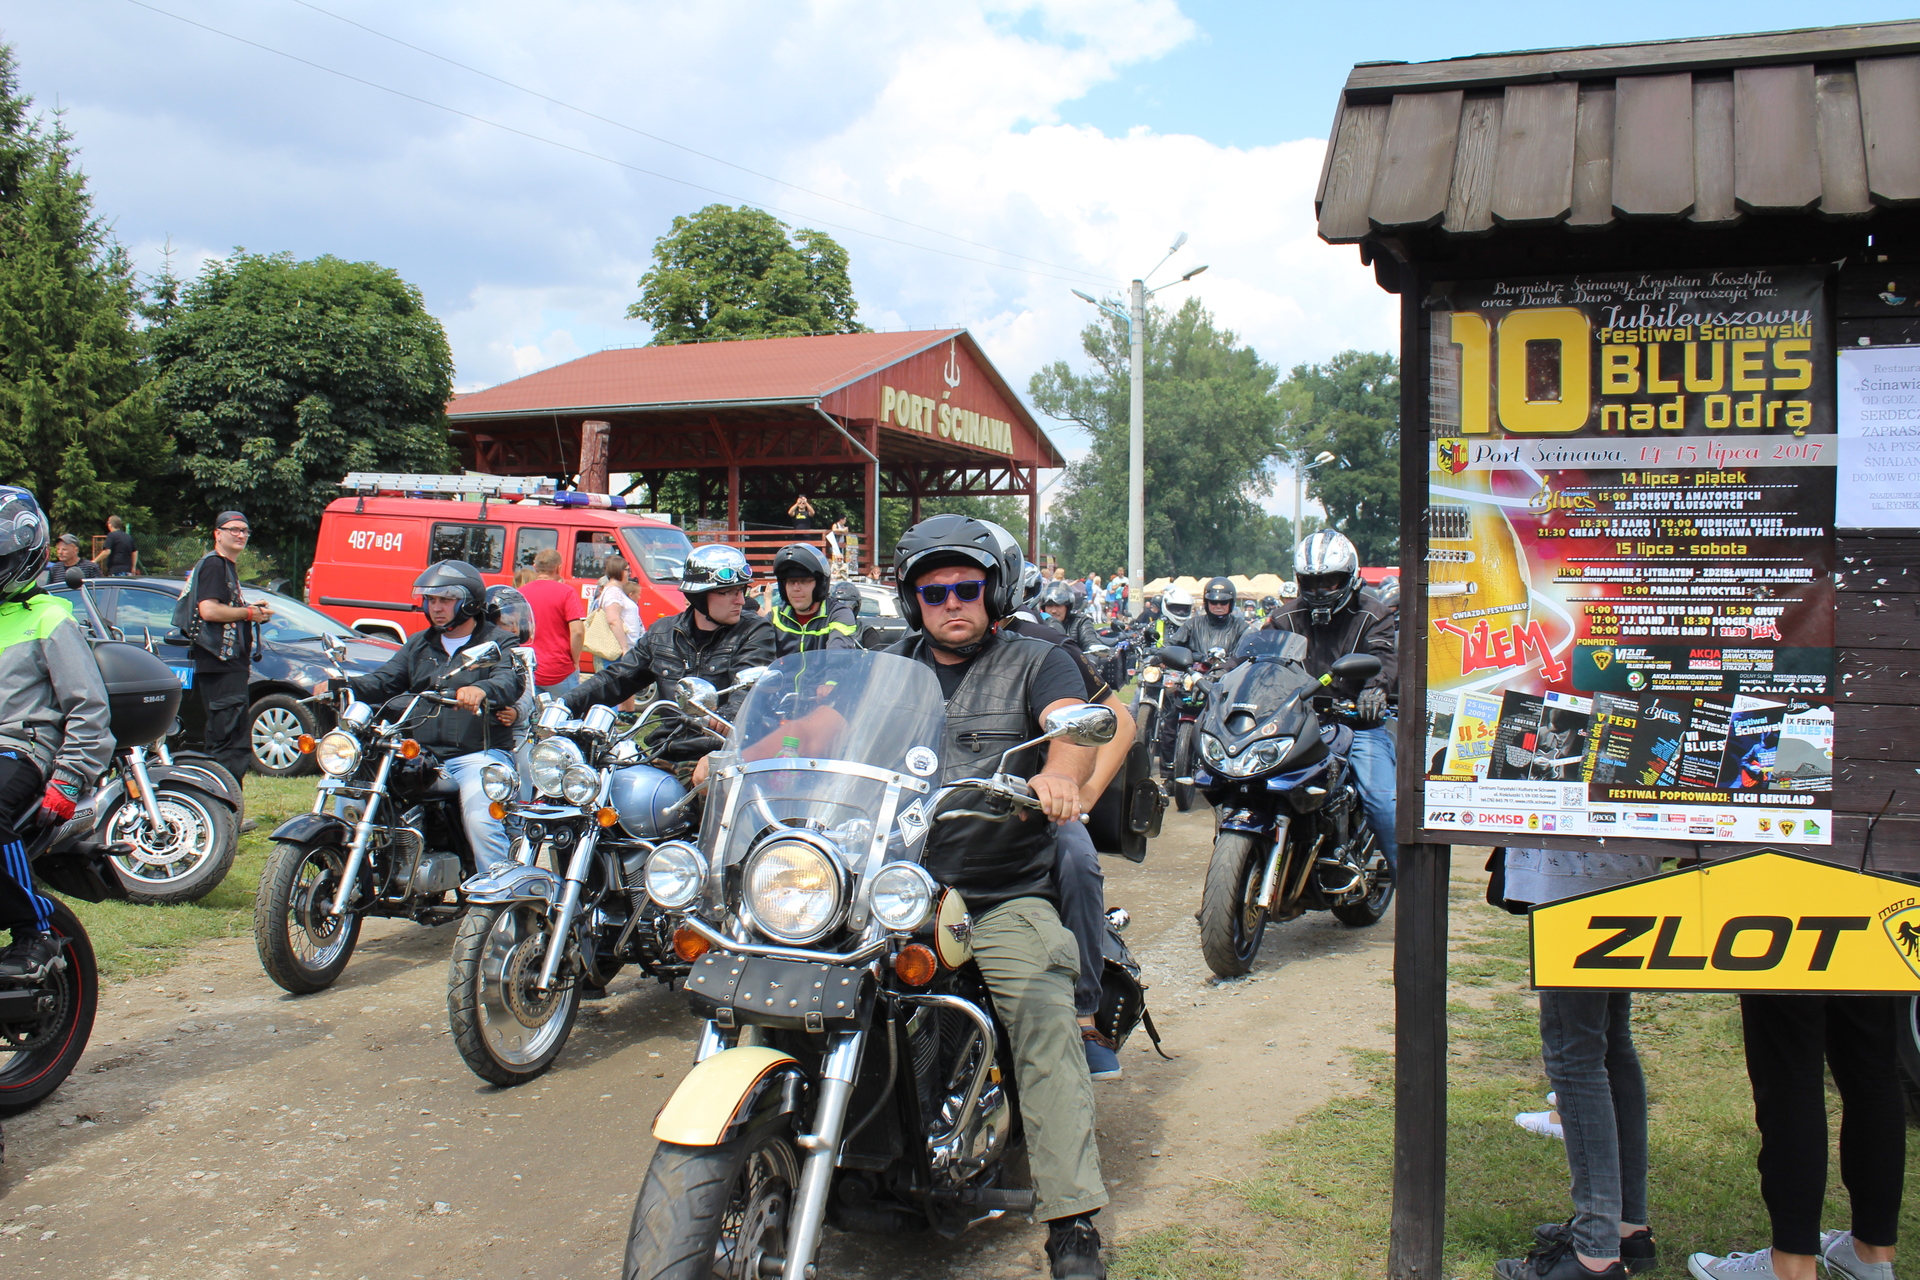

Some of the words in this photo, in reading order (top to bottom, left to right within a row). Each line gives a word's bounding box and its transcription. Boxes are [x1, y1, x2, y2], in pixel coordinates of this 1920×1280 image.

[1493, 281, 1564, 296] Burmistrz
[1570, 275, 1630, 295] Ścinawy
[1636, 274, 1701, 293] Krystian
[1707, 270, 1772, 290] Kosztyła
[1481, 299, 1513, 308] oraz
[1518, 291, 1562, 306] Darek
[1625, 287, 1662, 302] Łach
[1668, 286, 1748, 305] zapraszają
[1754, 287, 1778, 297] na:
[1601, 303, 1813, 330] Jubileuszowy
[1601, 325, 1692, 344] Festiwal
[1700, 319, 1812, 341] Ścinawski
[1449, 306, 1592, 434] 10
[1601, 340, 1812, 395] BLUES
[881, 385, 936, 434] PORT
[937, 390, 1014, 455] ŚCINAWA
[1601, 395, 1685, 431] nad
[1704, 393, 1812, 437] Odrą
[1867, 442, 1886, 452] NA
[1471, 444, 1521, 464] Port
[1639, 445, 1698, 464] 14-15
[1706, 439, 1761, 470] lipca
[1771, 443, 1825, 463] 2017
[1621, 472, 1637, 484] 14
[1641, 472, 1680, 486] lipca
[1695, 471, 1747, 486] piątek
[1598, 493, 1627, 501] 15:00
[1632, 491, 1682, 501] KONKURS
[1685, 491, 1762, 501] AMATORSKICH
[1614, 500, 1670, 510] ZESPOŁÓW
[1673, 501, 1744, 510] BLUESOWYCH
[1580, 519, 1609, 528] 18:30
[1611, 519, 1618, 528] 5
[1621, 519, 1651, 528] RANO
[1660, 519, 1692, 528] 20:00
[1695, 518, 1747, 528] MIDNIGHT
[1750, 518, 1784, 528] BLUES
[1538, 528, 1566, 537] 21:30
[1568, 528, 1601, 537] CHEAP
[1604, 528, 1651, 537] TOBACCO
[1667, 528, 1698, 537] 23:00
[1701, 527, 1752, 537] OBSTAWA
[1755, 527, 1824, 537] PREZYDENTA
[1616, 542, 1632, 555] 15
[1637, 542, 1675, 557] lipca
[1690, 542, 1748, 555] sobota
[1557, 568, 1582, 577] 11:00
[1584, 566, 1634, 577] ŚNIADANIE
[1635, 568, 1642, 577] Z
[1644, 568, 1694, 577] LITERATEM
[1702, 568, 1763, 577] ZDZISŁAWEM
[1765, 568, 1813, 580] PAJĄKIEM
[1622, 586, 1649, 595] 13:00
[1650, 586, 1689, 595] PARADA
[1690, 586, 1746, 596] MOTOCYKLI
[1452, 609, 1486, 620] GWIAZDA
[1584, 605, 1611, 614] 14:00
[1612, 605, 1655, 615] TANDETA
[1656, 606, 1686, 615] BLUES
[1687, 606, 1714, 615] BAND
[1726, 606, 1752, 615] 15:30
[1753, 606, 1785, 616] GRUFF
[1592, 615, 1618, 624] 17:00
[1638, 616, 1665, 625] BAND
[1683, 616, 1711, 625] 18:30
[1712, 616, 1748, 626] BOOGIE
[1749, 617, 1776, 626] BOYS
[1590, 626, 1619, 635] 20:00
[1622, 626, 1649, 635] DARO
[1650, 626, 1680, 635] BLUES
[1681, 626, 1708, 636] BAND
[1720, 627, 1748, 637] 21:30
[1627, 648, 1647, 656] ZLOT
[1689, 649, 1721, 660] AKCJA
[1688, 659, 1713, 668] DKMS
[1467, 700, 1478, 708] 25
[1478, 703, 1497, 712] lipca
[1468, 709, 1486, 718] 2009
[1786, 717, 1794, 725] IX
[1786, 725, 1822, 735] BLUES
[1683, 740, 1726, 753] BLUES
[1455, 762, 1471, 770] godz
[1608, 788, 1657, 801] FESTIWAL
[1660, 790, 1731, 803] POPROWADZI:
[1732, 792, 1758, 804] LECH
[1759, 793, 1815, 805] BEKULARD
[1478, 813, 1513, 825] DKMS
[1717, 814, 1735, 823] Puls
[1878, 897, 1915, 920] MOTO
[1572, 914, 1871, 973] ZLOT
